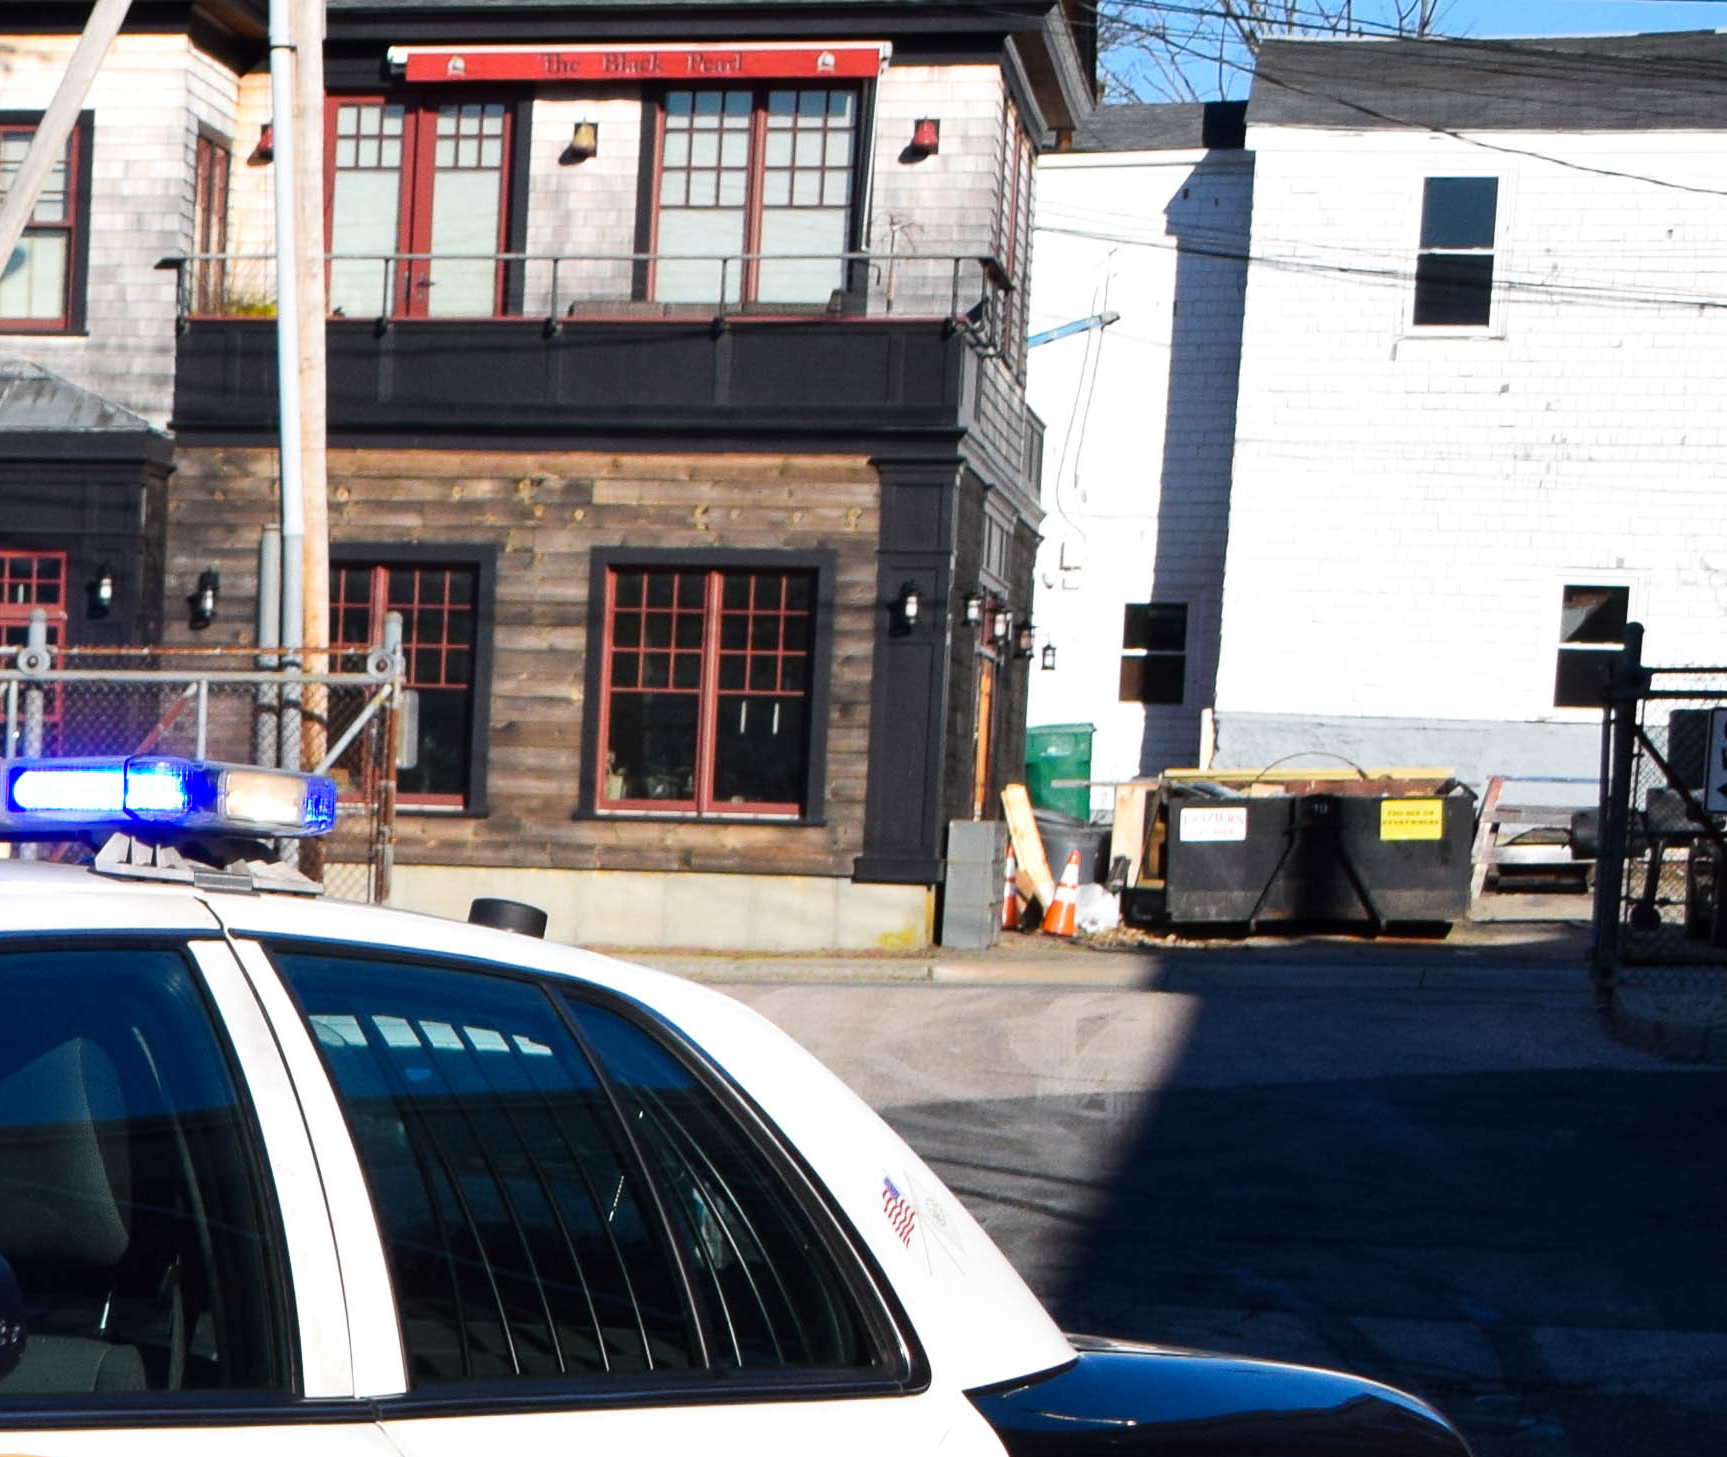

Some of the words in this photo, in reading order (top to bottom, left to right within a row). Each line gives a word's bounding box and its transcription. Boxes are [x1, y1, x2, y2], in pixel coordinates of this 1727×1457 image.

[540, 52, 579, 73] The
[602, 52, 663, 74] Black
[688, 52, 743, 73] Pearl
